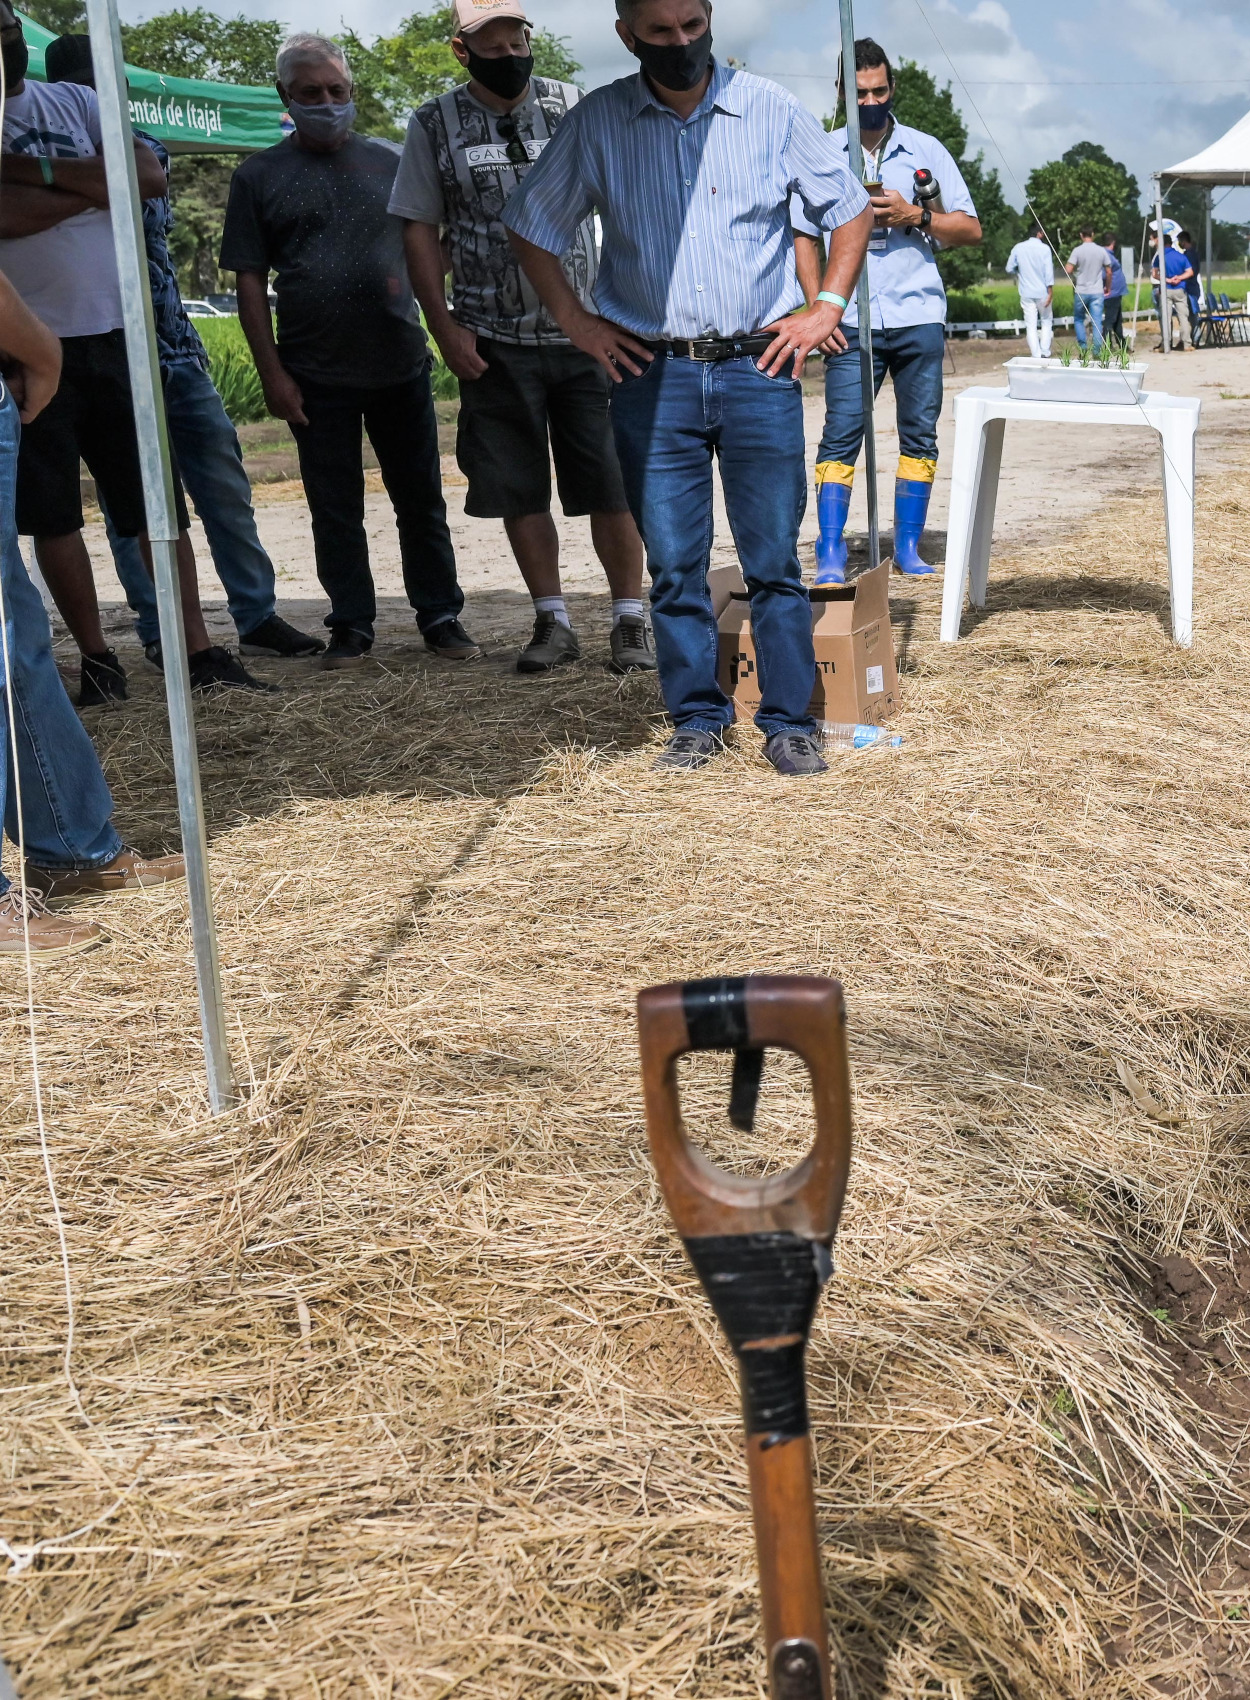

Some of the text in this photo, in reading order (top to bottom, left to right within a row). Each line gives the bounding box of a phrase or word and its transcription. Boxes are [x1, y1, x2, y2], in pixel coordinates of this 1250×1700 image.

[166, 97, 184, 127] de
[186, 100, 222, 137] Itajaí
[469, 144, 544, 162] GANST
